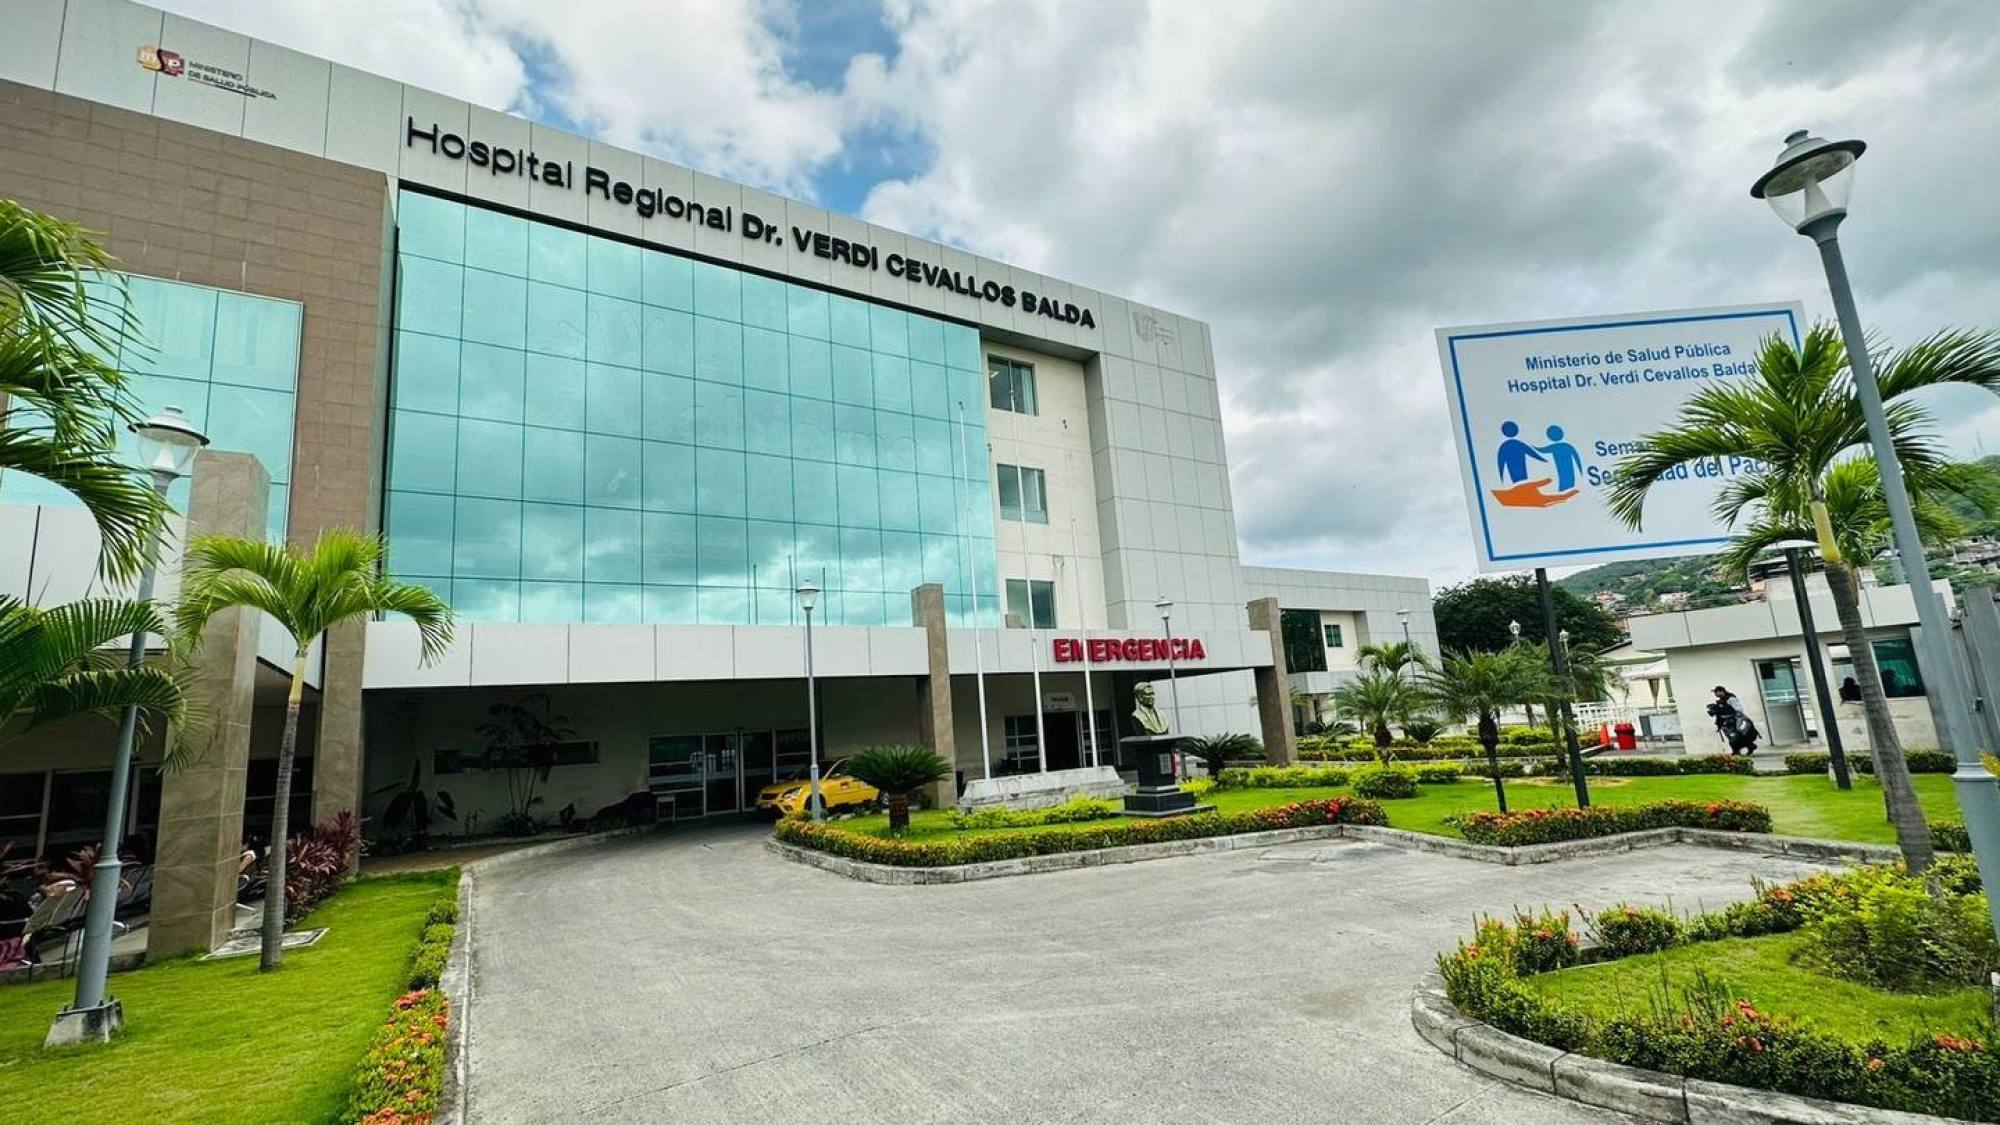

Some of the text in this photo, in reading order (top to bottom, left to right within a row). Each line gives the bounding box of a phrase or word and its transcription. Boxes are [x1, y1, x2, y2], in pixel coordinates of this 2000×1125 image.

[406, 116, 1096, 330] Hospital Regional Dr. VERDI CEVALLOS BALDA
[1525, 342, 1731, 370] Ministerio de Salud Pública
[1507, 361, 1757, 393] Hospital Dr. Verdi Cevallos Balda
[1695, 455, 1724, 478] del
[1053, 638, 1206, 663] EMERGENCIA
